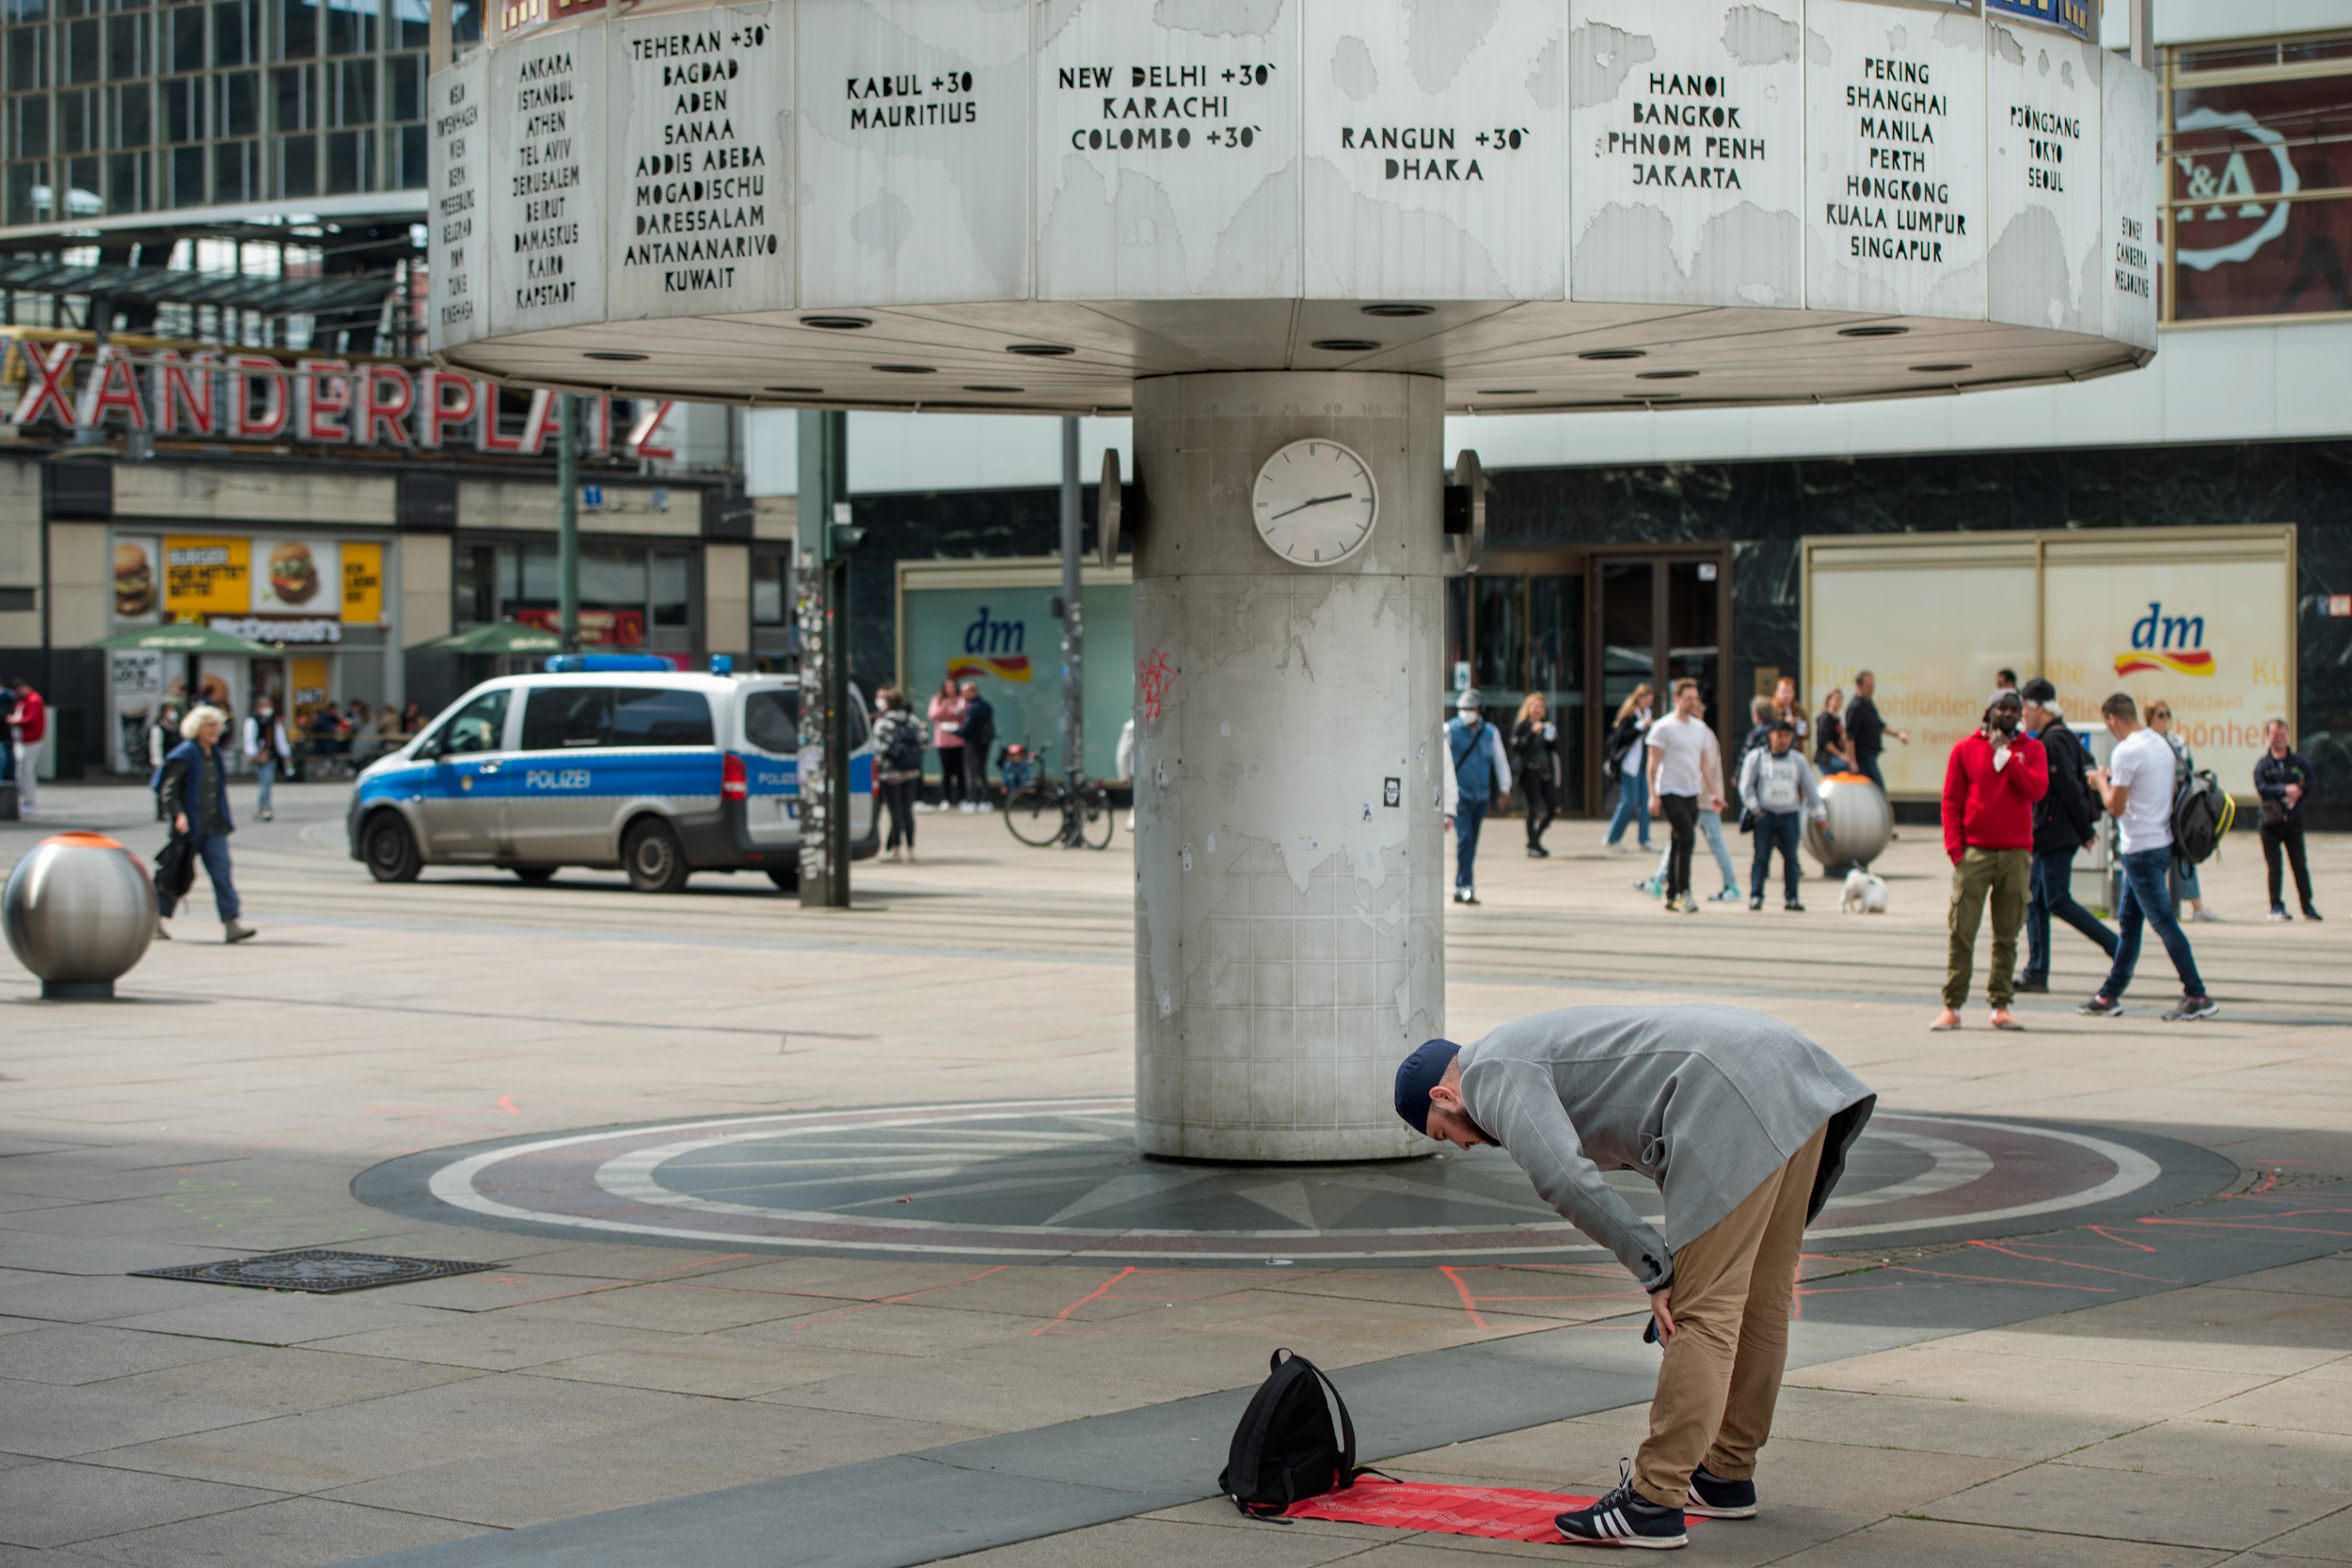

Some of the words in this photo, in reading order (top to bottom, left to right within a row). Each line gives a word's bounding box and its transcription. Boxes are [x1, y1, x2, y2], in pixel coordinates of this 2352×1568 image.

[633, 30, 721, 60] TEHERAN
[519, 53, 573, 83] ANKARA
[663, 59, 739, 87] BAGDAD
[1058, 68, 1113, 89] NEW
[1132, 65, 1206, 87] DELHI
[1865, 56, 1930, 85] PEKING
[518, 83, 574, 111] ISTANBUL
[847, 74, 922, 99] KABUL
[931, 71, 973, 93] +30
[1649, 72, 1725, 98] HANOI
[675, 89, 726, 115] ADEN
[1103, 95, 1229, 119] KARACHI
[1847, 86, 1947, 116] SHANGHAI
[527, 111, 565, 137] ATHEN
[850, 102, 977, 130] MAURITIUS
[1633, 103, 1741, 129] BANGKOK
[2010, 105, 2080, 139] PJÖNGJANG
[664, 119, 734, 145] SANAA
[1072, 127, 1191, 150] COLOMBO
[1342, 127, 1454, 149] RANGUN
[1861, 118, 1933, 144] MANILA
[520, 147, 539, 167] TEL
[544, 138, 571, 163] AVIV
[1608, 132, 1692, 157] PHNOM
[1706, 135, 1765, 160] PENH
[1870, 148, 1925, 172] PERTH
[2029, 138, 2062, 165] TOKYO
[636, 151, 691, 178] ADDIS
[703, 146, 766, 171] ABEBA
[1385, 158, 1485, 181] DHAKA
[513, 166, 580, 197] JERUSALEM
[636, 175, 764, 207] MOGADISCHU
[1632, 164, 1741, 190] JAKARTA
[1847, 175, 1948, 205] HONGKONG
[2028, 167, 2063, 192] SEOUL
[526, 198, 565, 223] BEIRUT
[636, 205, 764, 236] DARESSALAM
[1827, 203, 1887, 229] KUALA
[1898, 209, 1966, 236] LUMPUR
[515, 224, 578, 252] DAMASKUS
[2122, 216, 2142, 242] SYDNEY
[624, 233, 777, 266] ANTANANARIVO
[1851, 236, 1943, 262] SINGAPUR
[2117, 242, 2148, 272] CANBERRA
[529, 255, 564, 280] KAIRO
[664, 267, 734, 293] KUWAIT
[516, 281, 576, 309] KAPSTADT
[2115, 268, 2149, 299] MELBOURNE
[1324, 404, 1342, 414] 90
[1362, 404, 1382, 416] 105
[964, 607, 1025, 654] dm
[2131, 602, 2205, 649] dm
[2176, 719, 2266, 749] hönhei
[526, 769, 591, 789] POLIZEI
[758, 771, 799, 785] POLIZE
